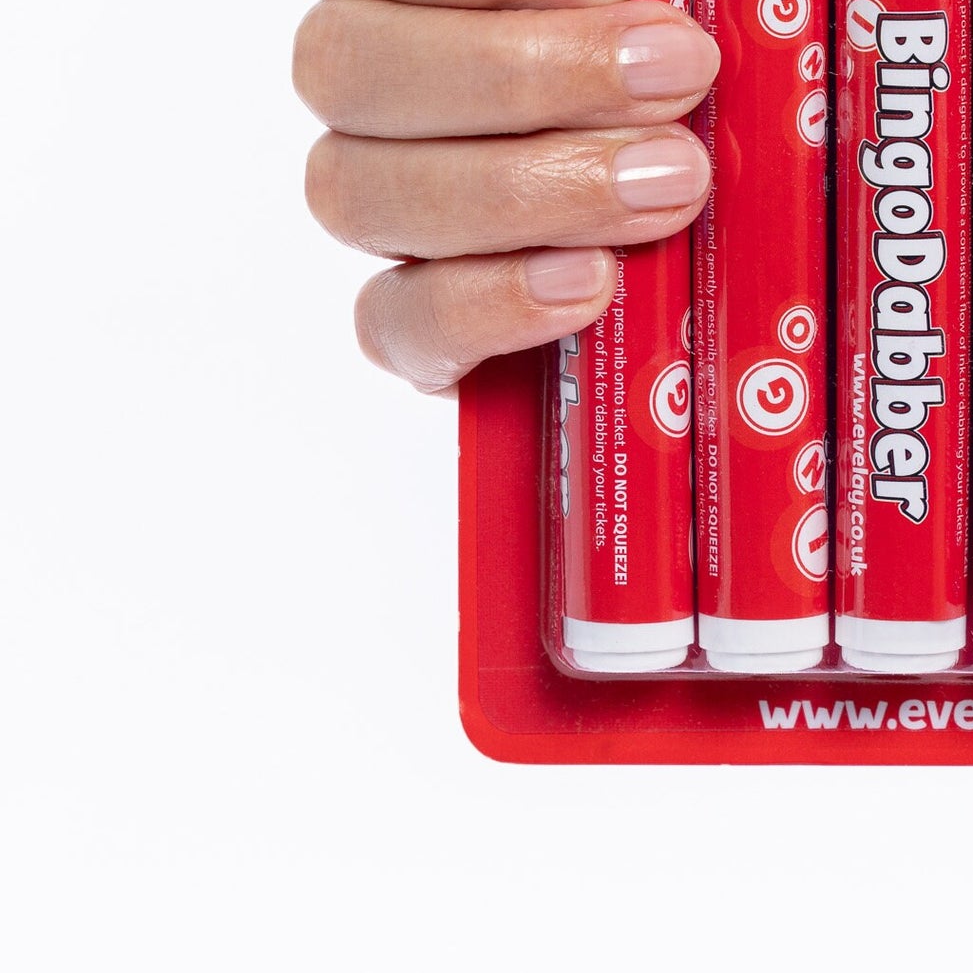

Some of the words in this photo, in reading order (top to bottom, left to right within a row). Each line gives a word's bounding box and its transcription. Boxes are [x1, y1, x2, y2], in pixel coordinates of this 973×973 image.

[959, 6, 968, 59] product
[960, 64, 968, 74] is
[707, 87, 718, 127] bottle
[959, 77, 968, 140] designed
[960, 144, 967, 159] to
[959, 162, 967, 215] provide
[708, 223, 718, 249] and
[706, 253, 717, 296] gently
[857, 10, 951, 525] BingoDabber
[611, 308, 625, 343] press
[706, 300, 715, 334] press
[959, 303, 967, 333] flow
[595, 341, 607, 356] of
[614, 347, 627, 369] nib
[708, 339, 717, 360] nib
[959, 336, 967, 350] of
[595, 358, 607, 379] ink
[708, 364, 716, 396] onto
[959, 354, 967, 376] ink
[595, 382, 607, 401] for
[614, 373, 626, 405] onto
[959, 378, 967, 396] for
[614, 409, 627, 449] ticket.
[708, 400, 717, 440] ticket.
[614, 453, 627, 476] DO
[709, 444, 718, 467] DO
[848, 353, 869, 576] www.evelay.co.uk
[593, 468, 604, 499] your
[709, 471, 718, 502] NOT
[956, 463, 964, 494] your
[614, 480, 627, 510] NOT
[595, 502, 607, 549] tickets.
[708, 505, 718, 577] SQUEEZE!
[613, 514, 627, 585] SQUEEZE!
